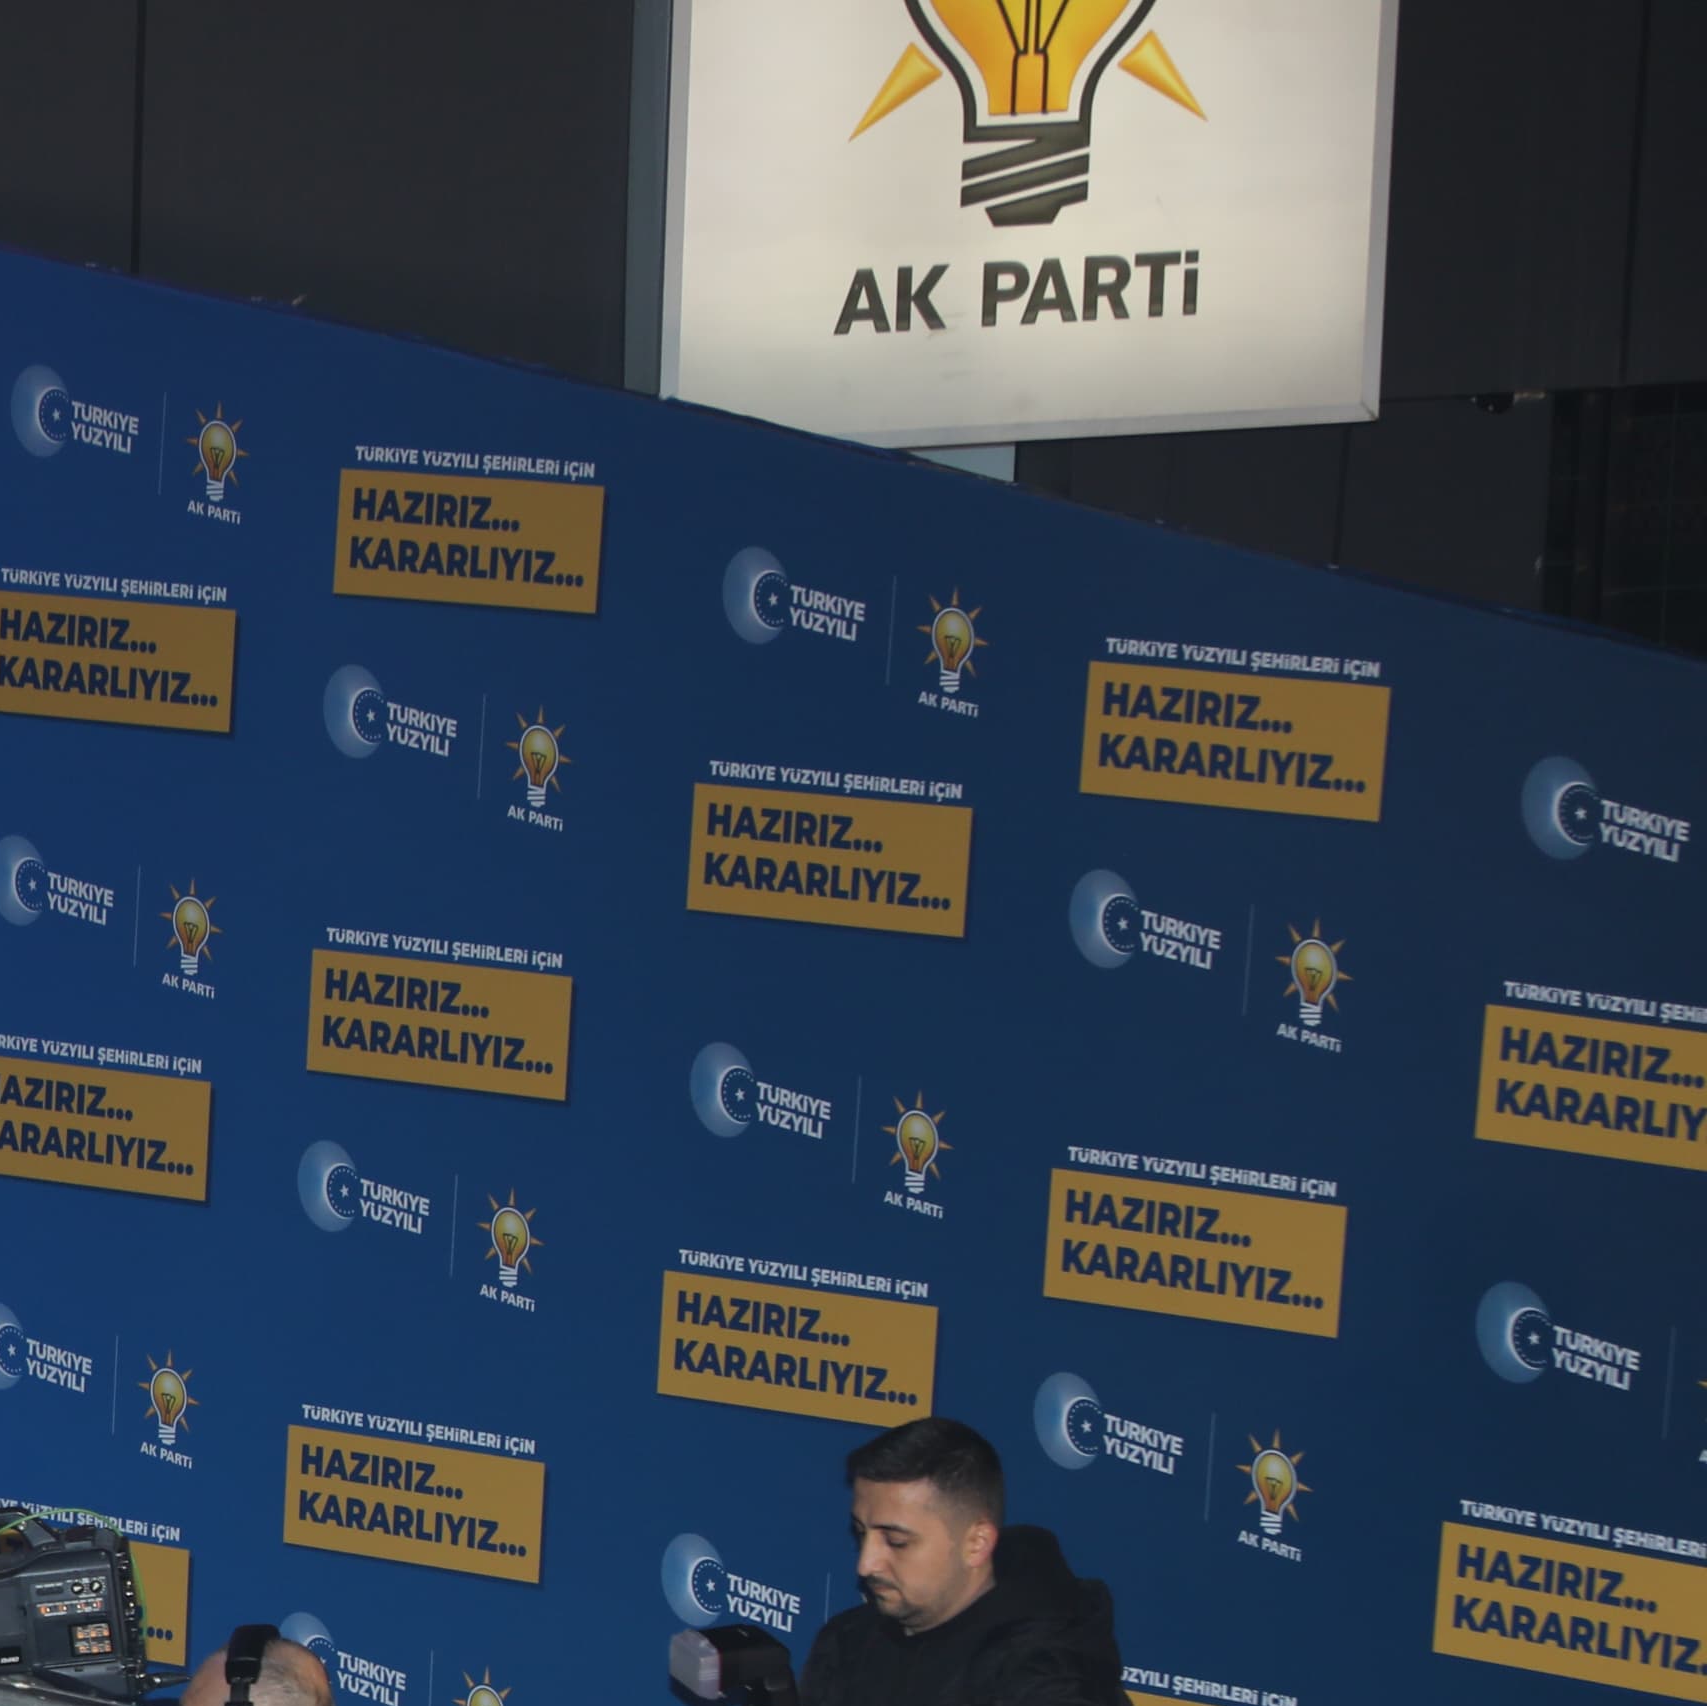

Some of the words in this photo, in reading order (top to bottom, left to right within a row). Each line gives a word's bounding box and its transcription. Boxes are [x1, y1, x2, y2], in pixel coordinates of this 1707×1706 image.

[833, 263, 950, 336] AK
[161, 973, 179, 989] AK
[479, 1284, 497, 1301] AK
[1237, 1530, 1258, 1548] AK
